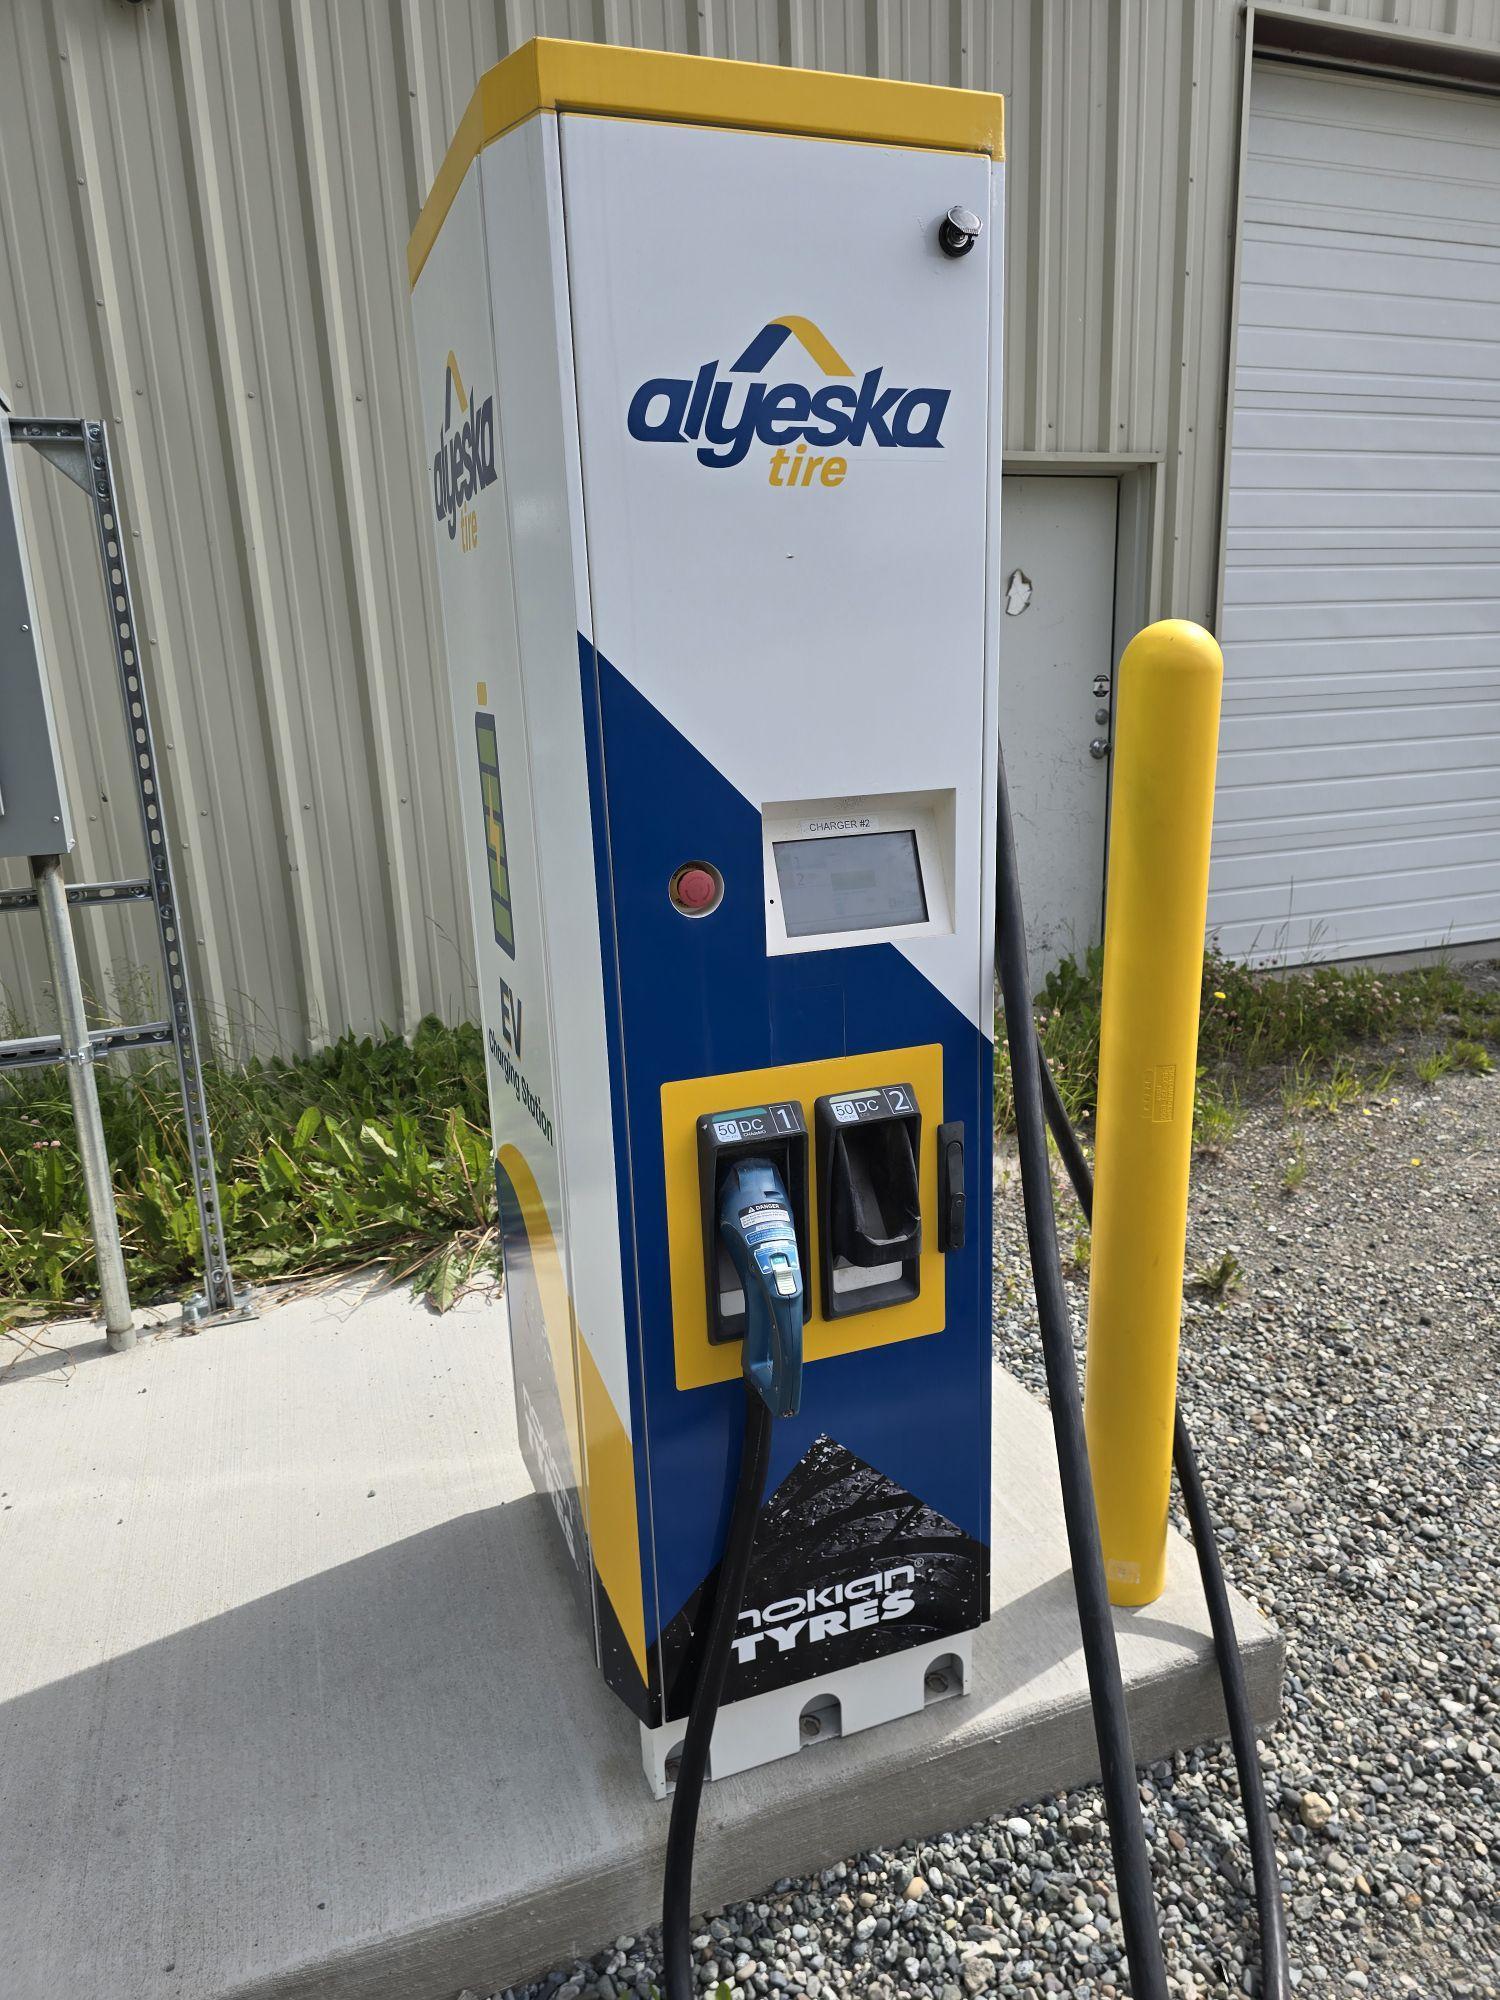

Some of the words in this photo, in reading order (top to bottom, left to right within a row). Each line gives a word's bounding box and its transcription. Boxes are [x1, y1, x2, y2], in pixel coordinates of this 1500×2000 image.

[627, 359, 951, 468] alyeska
[434, 386, 498, 540] alyeska
[768, 444, 848, 487] tire
[460, 500, 478, 553] tire
[809, 820, 857, 832] CHARGER
[859, 819, 870, 828] #2
[500, 976, 522, 1064] EV
[488, 1027, 521, 1102] Charging
[521, 1076, 553, 1147] Station
[835, 1104, 854, 1116] 50
[855, 1100, 879, 1113] DC
[888, 1090, 909, 1111] 2
[718, 1123, 737, 1136] 50
[738, 1118, 764, 1133] DC
[777, 1109, 792, 1129] 1
[755, 1203, 780, 1211] DANGER
[737, 1565, 915, 1628] nokian
[730, 1589, 916, 1665] TYRES
